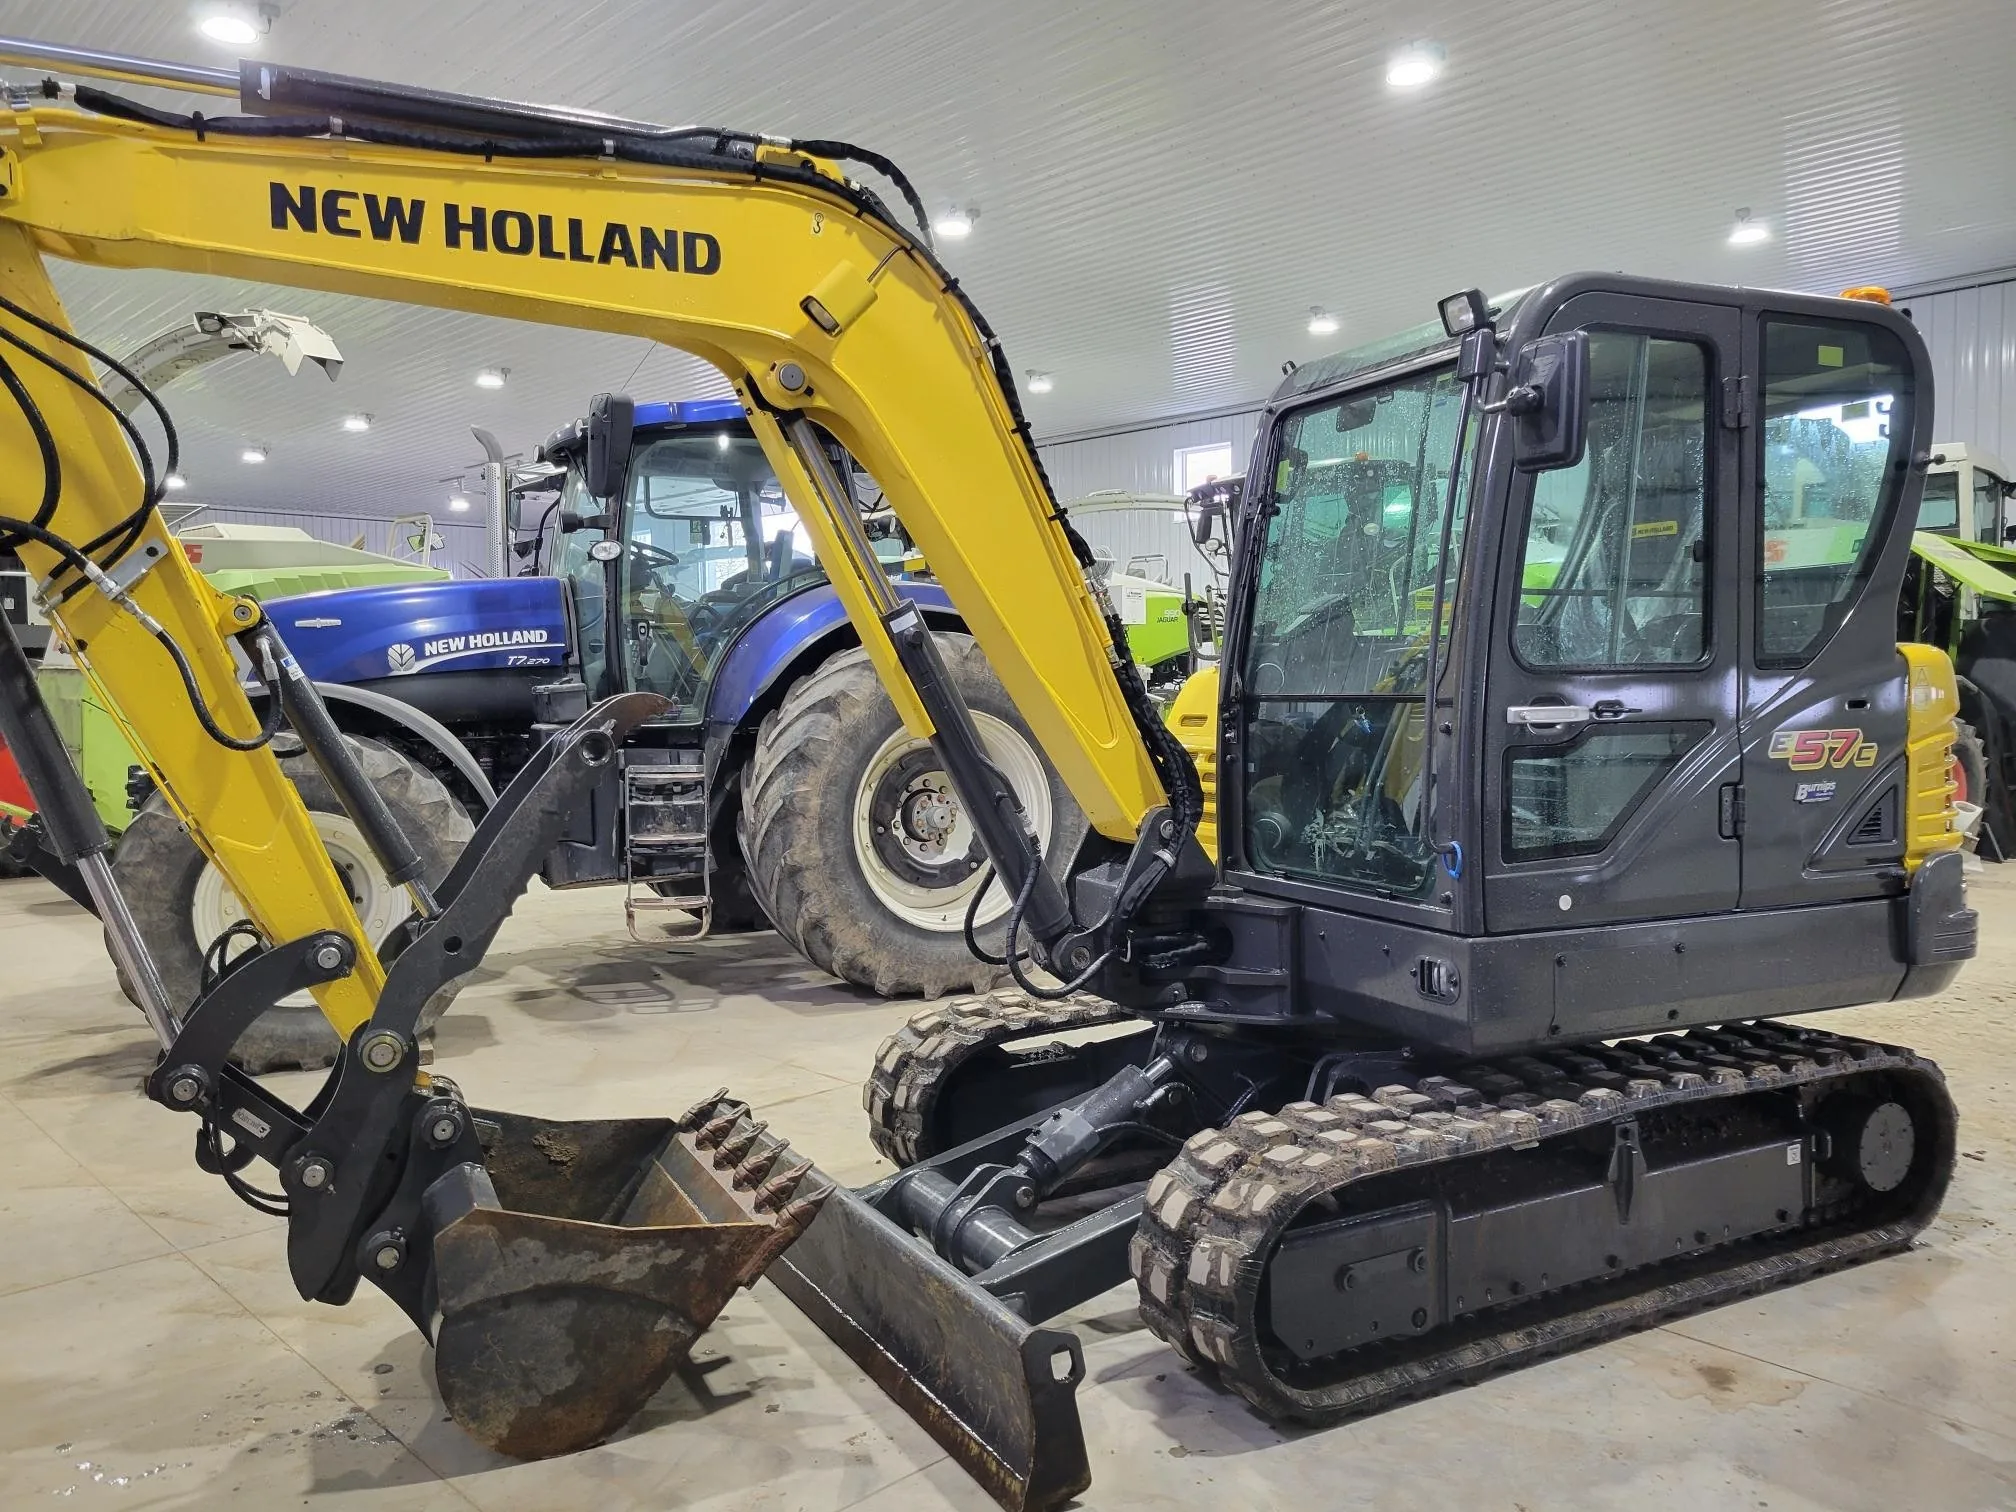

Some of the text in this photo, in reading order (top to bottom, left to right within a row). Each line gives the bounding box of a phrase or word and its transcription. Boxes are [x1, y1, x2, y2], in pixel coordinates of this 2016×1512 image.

[269, 181, 722, 276] NEW HOLLAND
[1156, 616, 1179, 624] JAGUAR
[425, 630, 547, 656] NEW HOLLAND
[507, 655, 550, 665] T7.270
